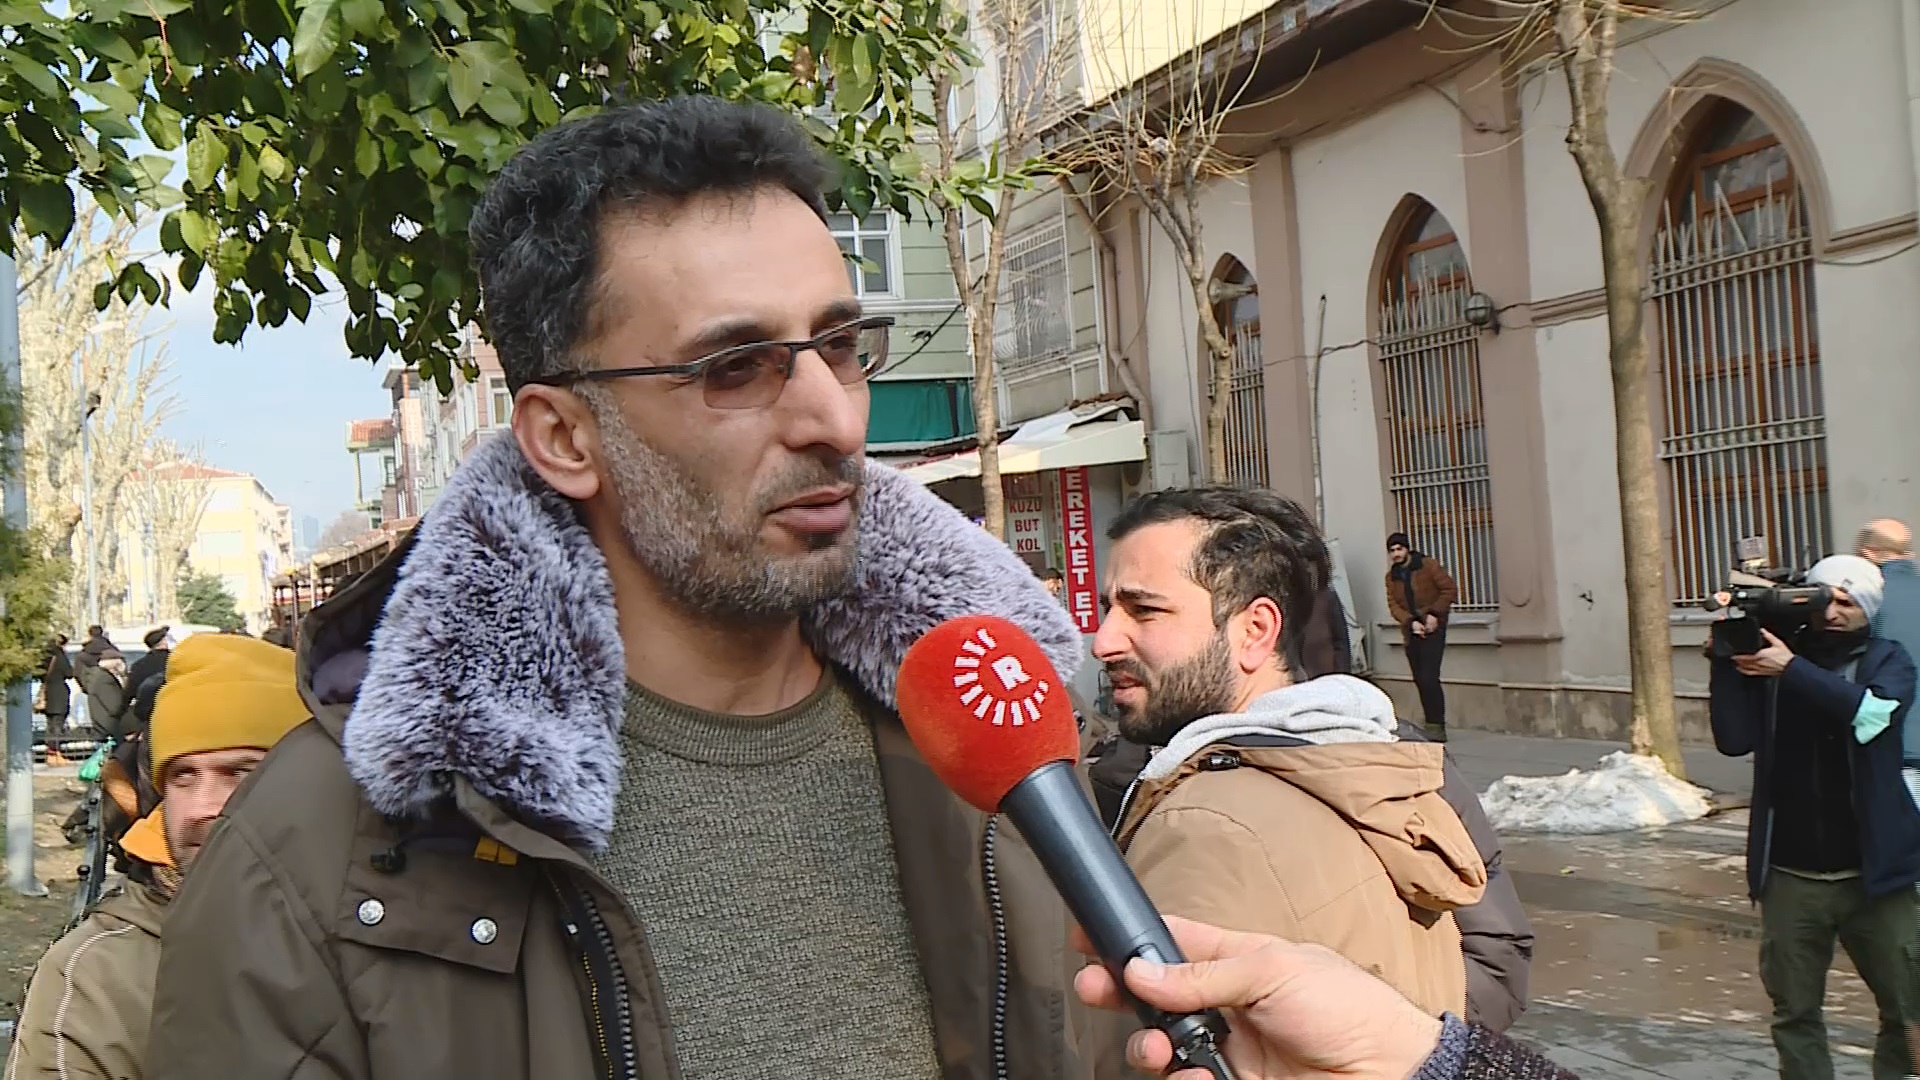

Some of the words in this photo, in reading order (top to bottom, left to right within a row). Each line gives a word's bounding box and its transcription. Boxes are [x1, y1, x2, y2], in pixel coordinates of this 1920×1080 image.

[1009, 500, 1042, 513] KUZU
[1014, 519, 1040, 533] BUT
[1066, 468, 1089, 585] EREKET
[1016, 538, 1041, 551] KOL
[1075, 591, 1093, 628] ET
[991, 655, 1032, 691] R
